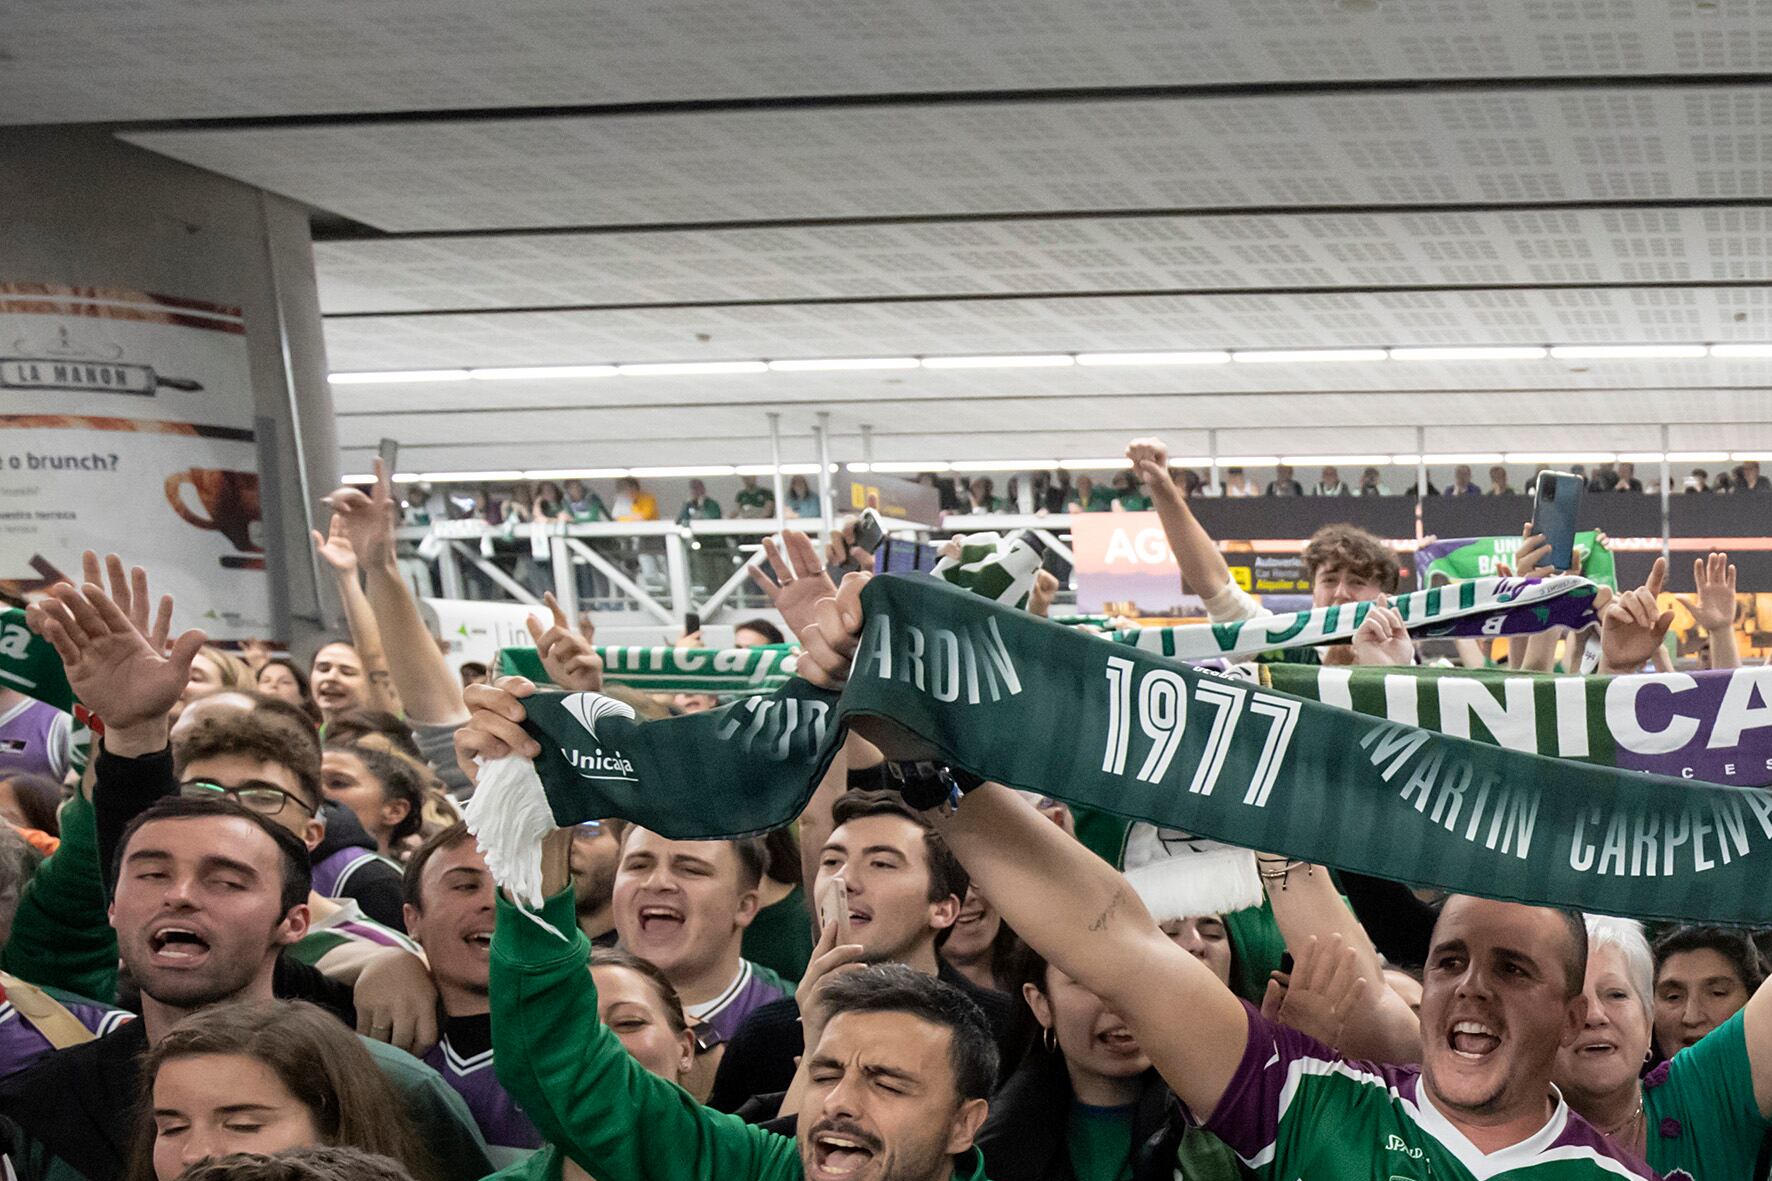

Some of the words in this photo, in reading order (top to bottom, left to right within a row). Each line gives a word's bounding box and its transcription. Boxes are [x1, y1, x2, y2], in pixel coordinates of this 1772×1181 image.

[18, 364, 40, 382] LA
[27, 452, 119, 471] brunch?
[1104, 527, 1177, 565] AG
[561, 749, 634, 774] Unicaja
[1102, 656, 1301, 807] 1977
[1360, 720, 1540, 860] MARTIN
